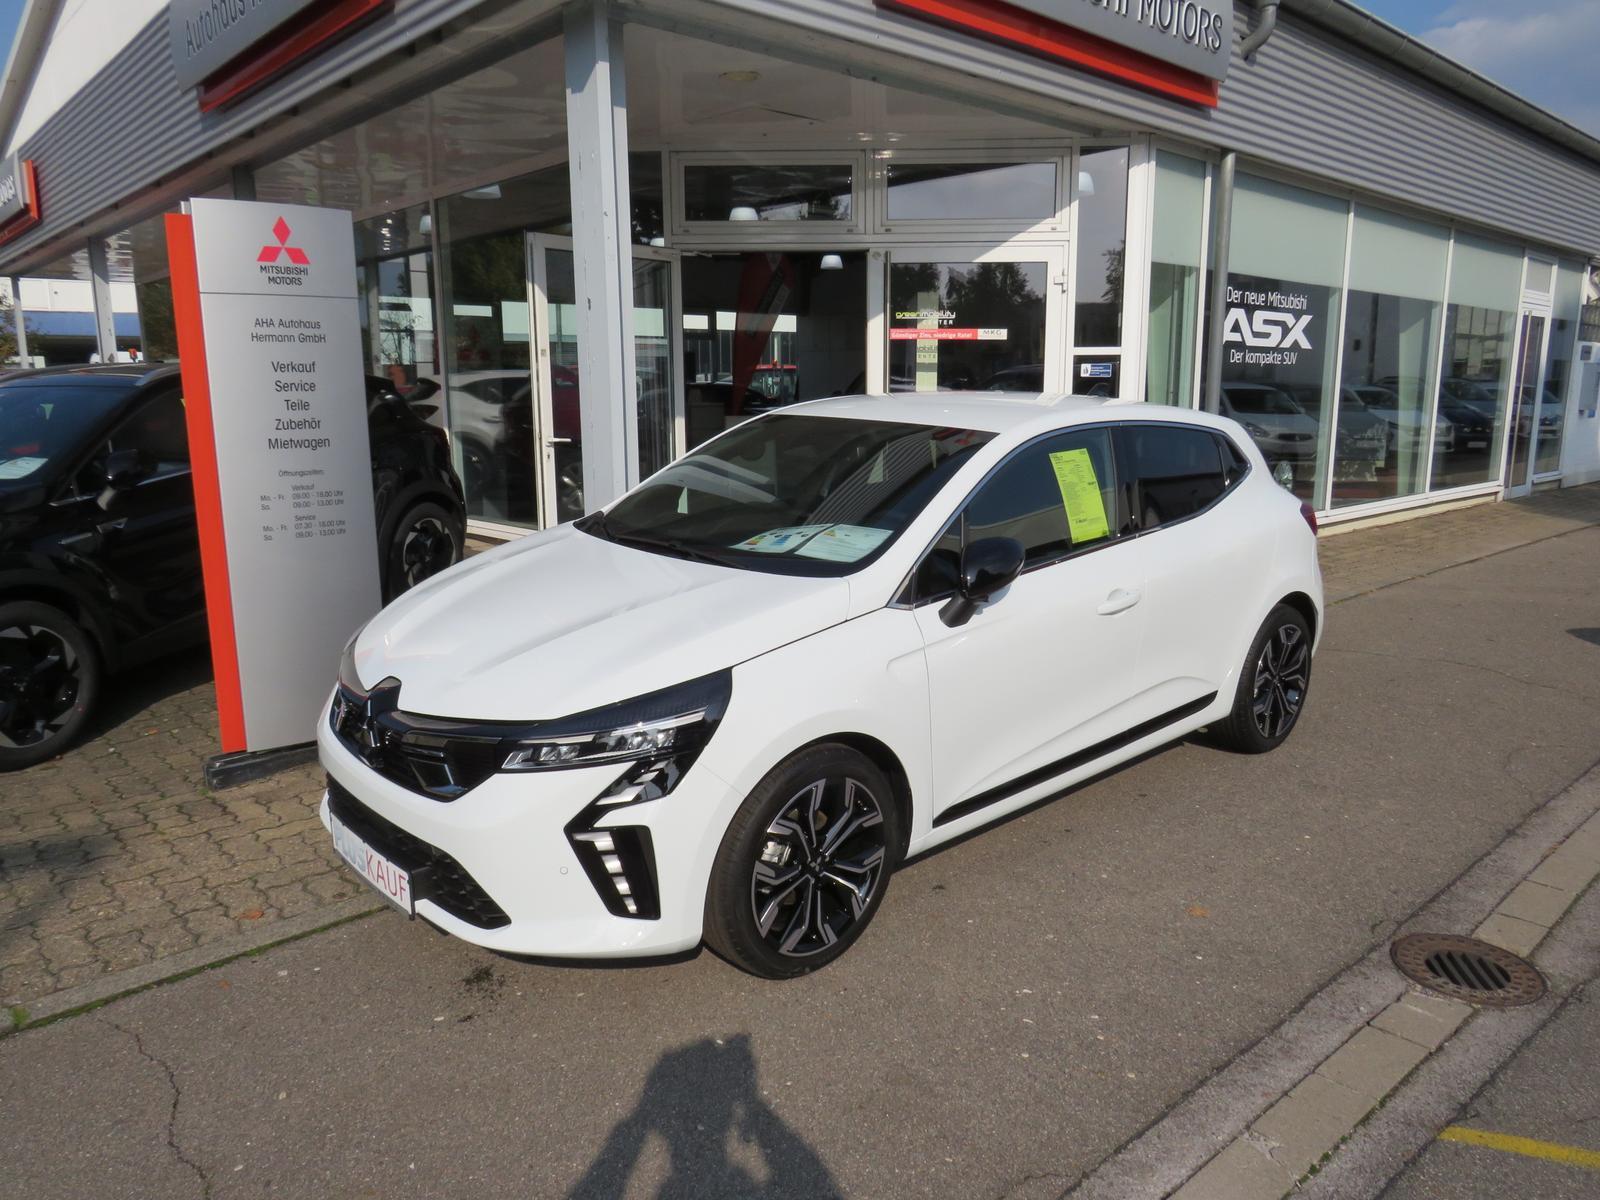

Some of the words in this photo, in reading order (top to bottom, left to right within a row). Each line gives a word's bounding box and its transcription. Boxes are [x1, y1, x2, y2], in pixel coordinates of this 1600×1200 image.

[185, 0, 247, 58] Autohaus
[1137, 0, 1223, 53] MOTORS
[259, 265, 309, 276] MITSUBISHI
[267, 276, 303, 286] MOTORS
[1226, 286, 1242, 303] Der
[1244, 290, 1266, 306] neue
[1267, 291, 1308, 310] Mitsubishi
[254, 318, 275, 328] AHA
[278, 318, 321, 329] Autohaus
[1222, 307, 1314, 350] ASX
[250, 332, 296, 342] Hermann
[298, 333, 327, 343] GmbH
[1230, 349, 1244, 363] Der
[1245, 350, 1281, 367] kompakte
[1283, 351, 1297, 365] SUV
[271, 361, 316, 373] Verkauf
[274, 380, 316, 392] Service
[283, 399, 310, 411] Teile
[275, 418, 321, 430] Zubehör
[268, 438, 331, 451] Mietwagen
